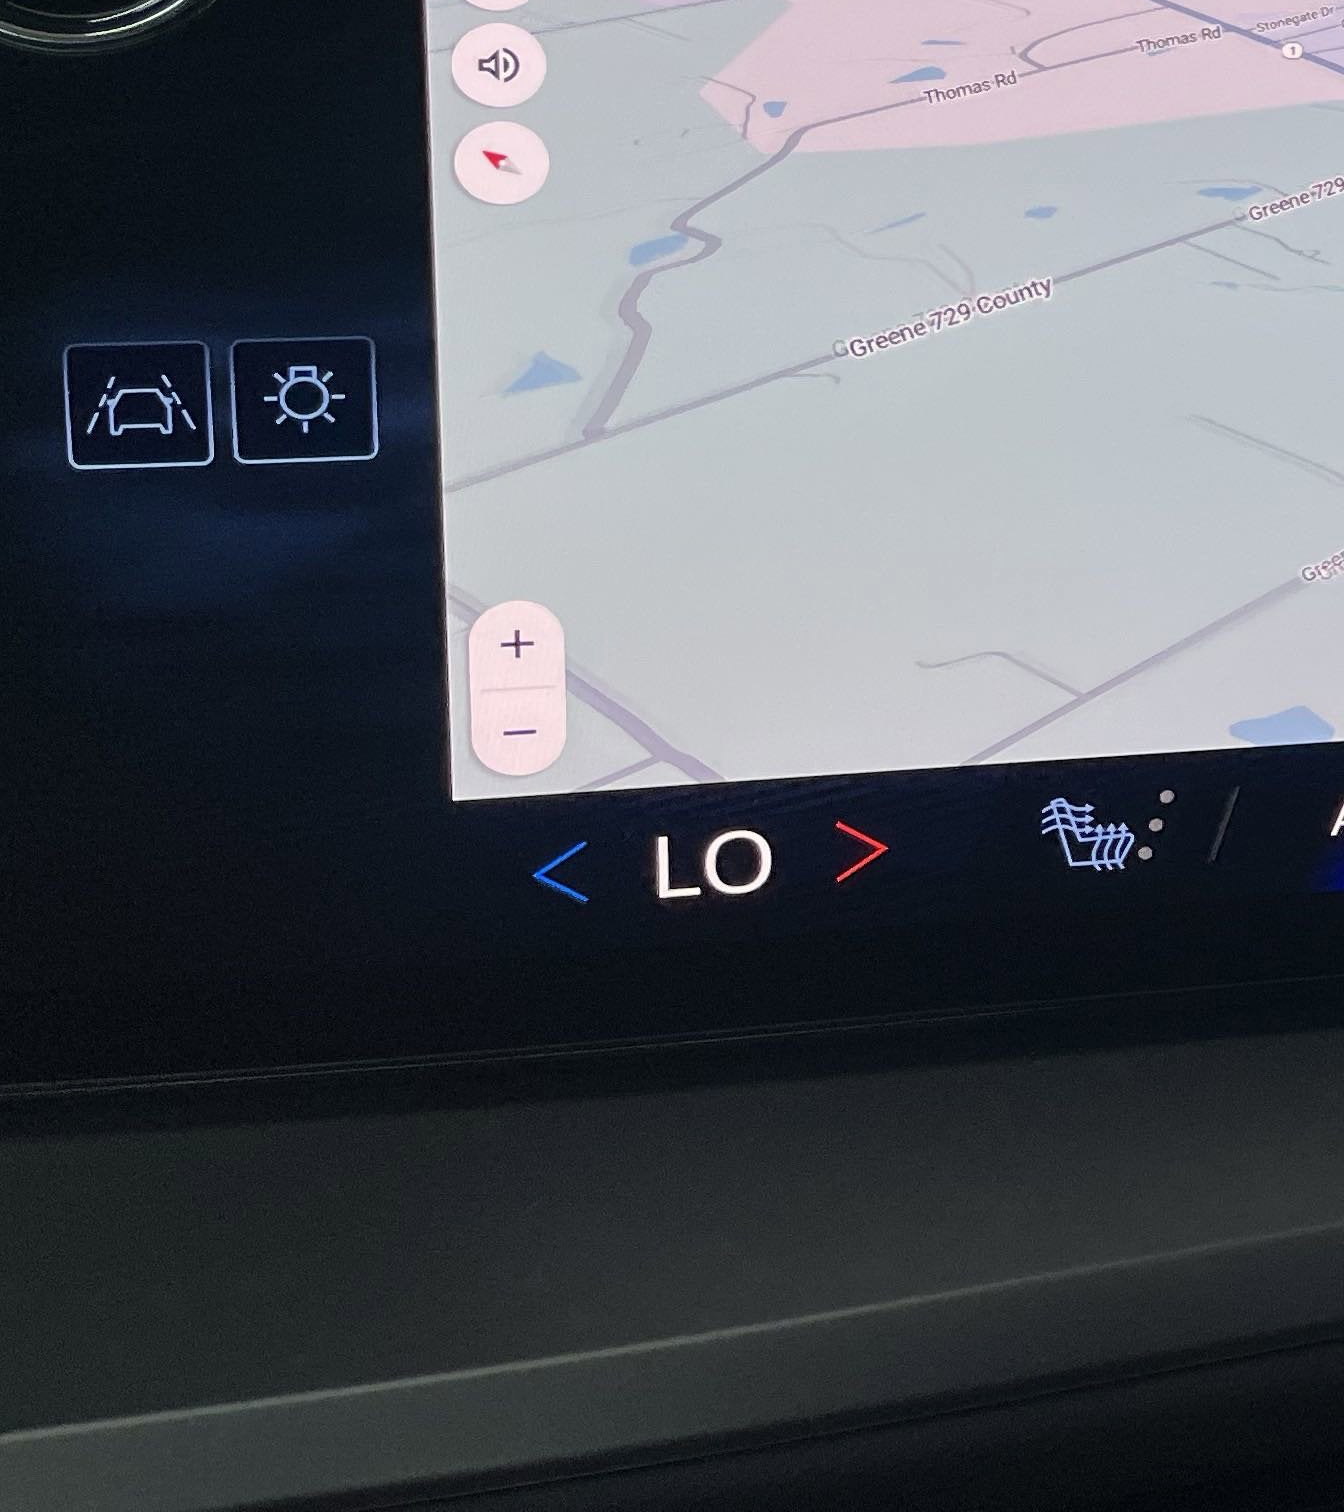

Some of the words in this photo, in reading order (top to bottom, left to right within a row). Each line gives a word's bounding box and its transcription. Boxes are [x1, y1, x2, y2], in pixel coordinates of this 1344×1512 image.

[1256, 10, 1318, 33] Stonegate
[1320, 5, 1335, 16] Dr
[1136, 31, 1197, 54] Thomas
[1200, 25, 1222, 41] Rd
[924, 78, 991, 105] Thomas
[994, 70, 1018, 88] Rd
[1248, 191, 1311, 221] Greene
[849, 320, 927, 357] Greene
[929, 302, 971, 330] 729
[976, 278, 1052, 314] County
[656, 829, 772, 898] LO
